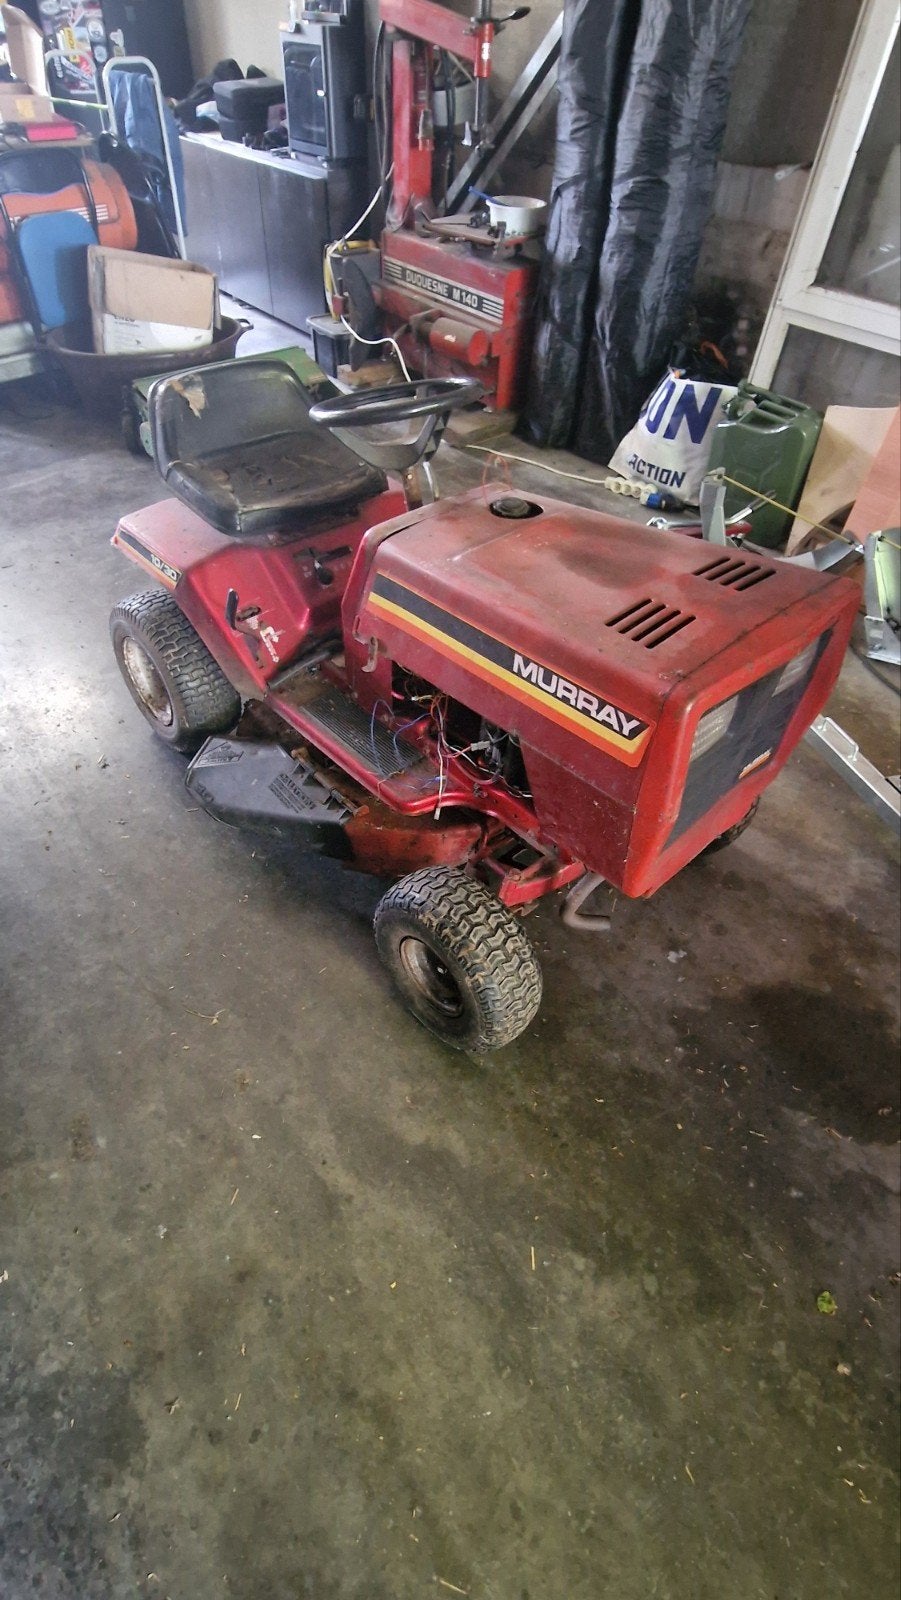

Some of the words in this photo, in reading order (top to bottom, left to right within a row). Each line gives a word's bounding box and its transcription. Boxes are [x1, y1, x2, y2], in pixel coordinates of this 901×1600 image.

[405, 269, 449, 297] DUQUESNE
[628, 453, 687, 489] ACTION
[512, 653, 641, 737] MURRAY
